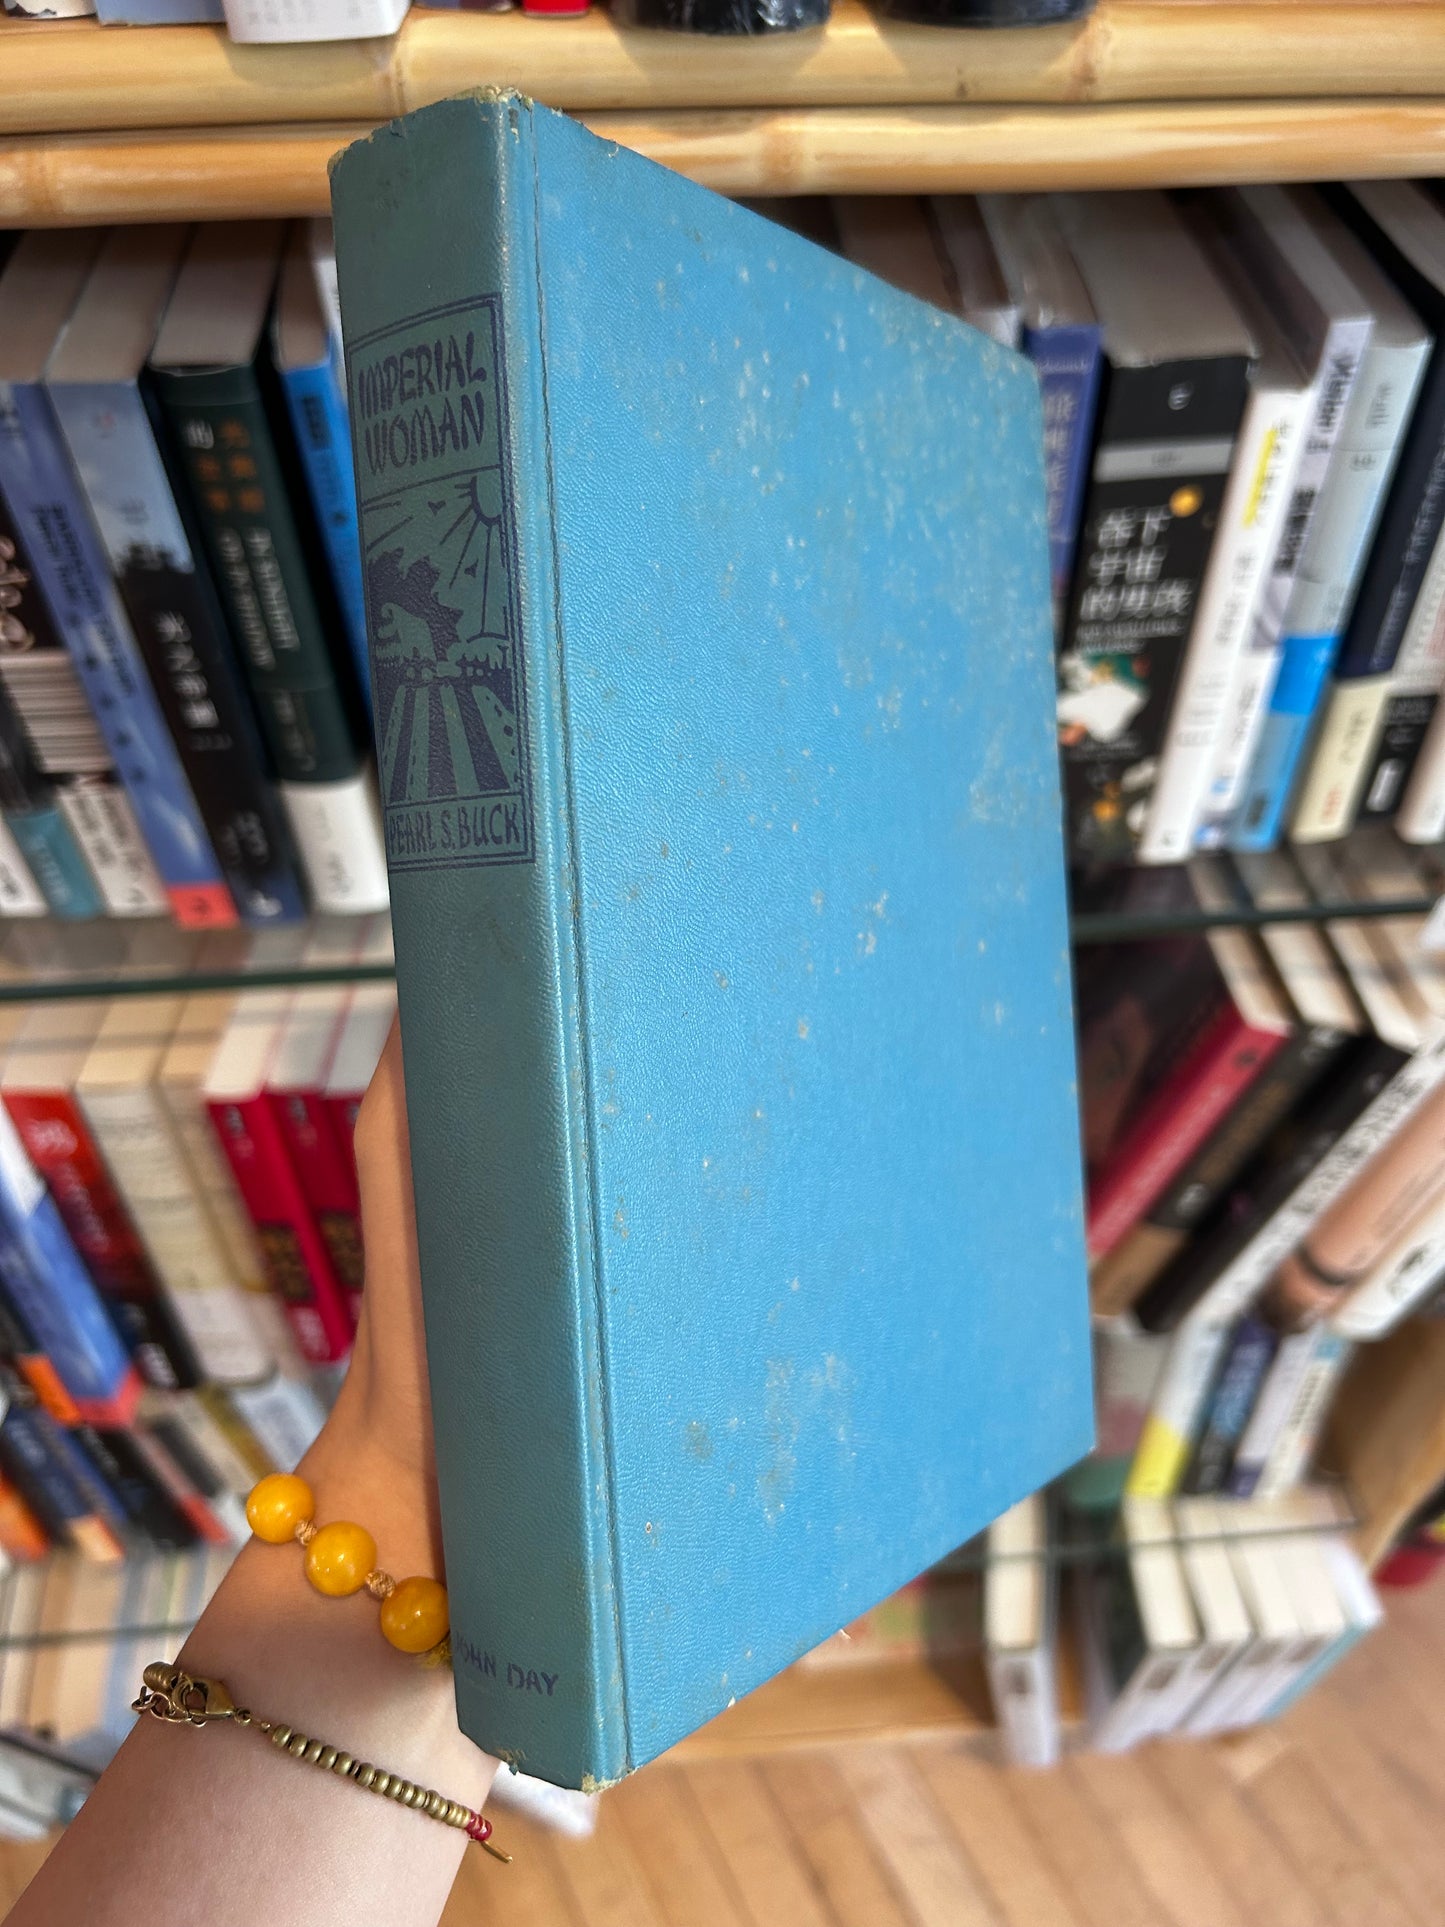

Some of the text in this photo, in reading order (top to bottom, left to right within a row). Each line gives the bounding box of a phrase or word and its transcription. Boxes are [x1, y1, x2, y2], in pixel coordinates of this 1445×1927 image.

[358, 331, 487, 420] IMPERIAL
[365, 390, 485, 475] WOMAN
[389, 811, 437, 855] PEARL
[457, 803, 521, 849] BUCK
[507, 1662, 559, 1697] DAY
